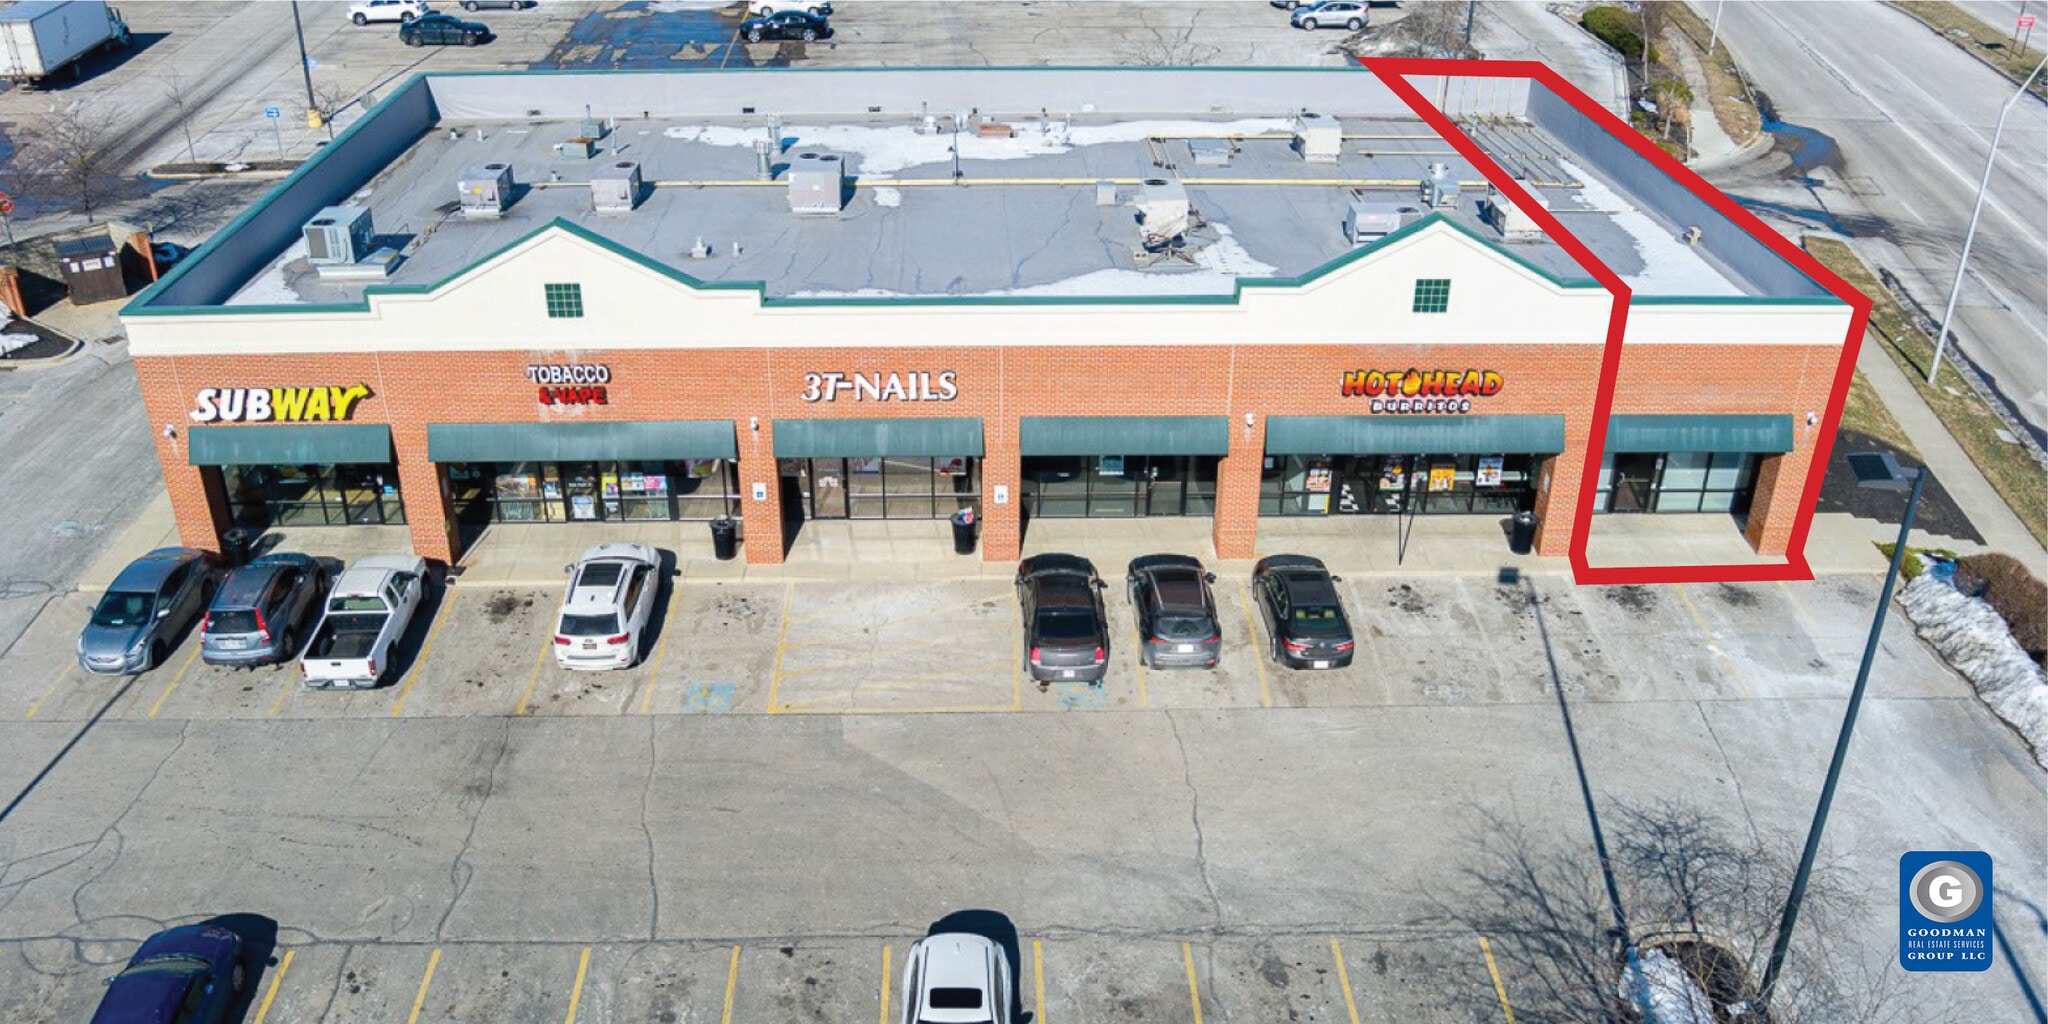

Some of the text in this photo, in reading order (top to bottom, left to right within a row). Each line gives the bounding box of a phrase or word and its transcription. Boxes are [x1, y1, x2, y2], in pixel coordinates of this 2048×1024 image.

[525, 364, 612, 384] TOBACCO
[801, 371, 958, 402] 3T-NAILS
[1342, 369, 1504, 397] HOT HEAD
[188, 382, 375, 423] SUBWAY
[1371, 399, 1472, 414] BURRITOS
